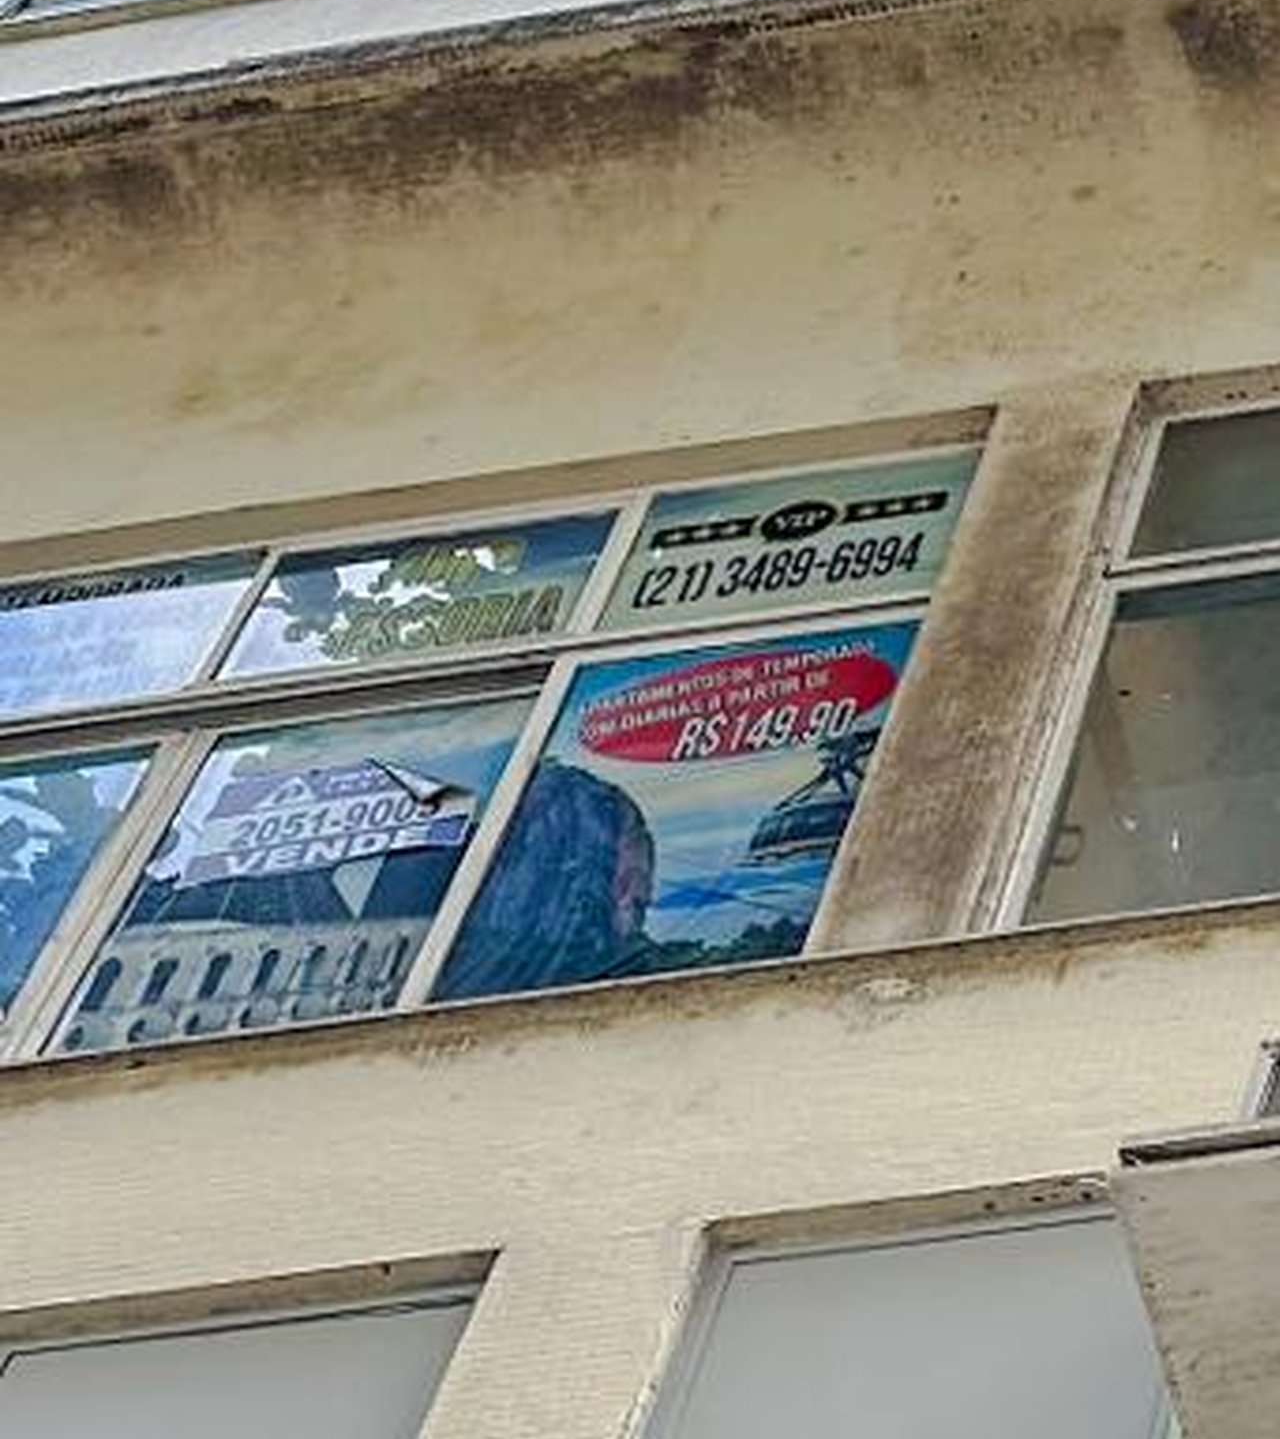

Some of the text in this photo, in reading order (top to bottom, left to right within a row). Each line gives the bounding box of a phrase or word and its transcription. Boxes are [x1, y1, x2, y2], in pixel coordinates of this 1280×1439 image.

[632, 532, 924, 609] (21) 3489-6994
[225, 822, 430, 876] VENDE
